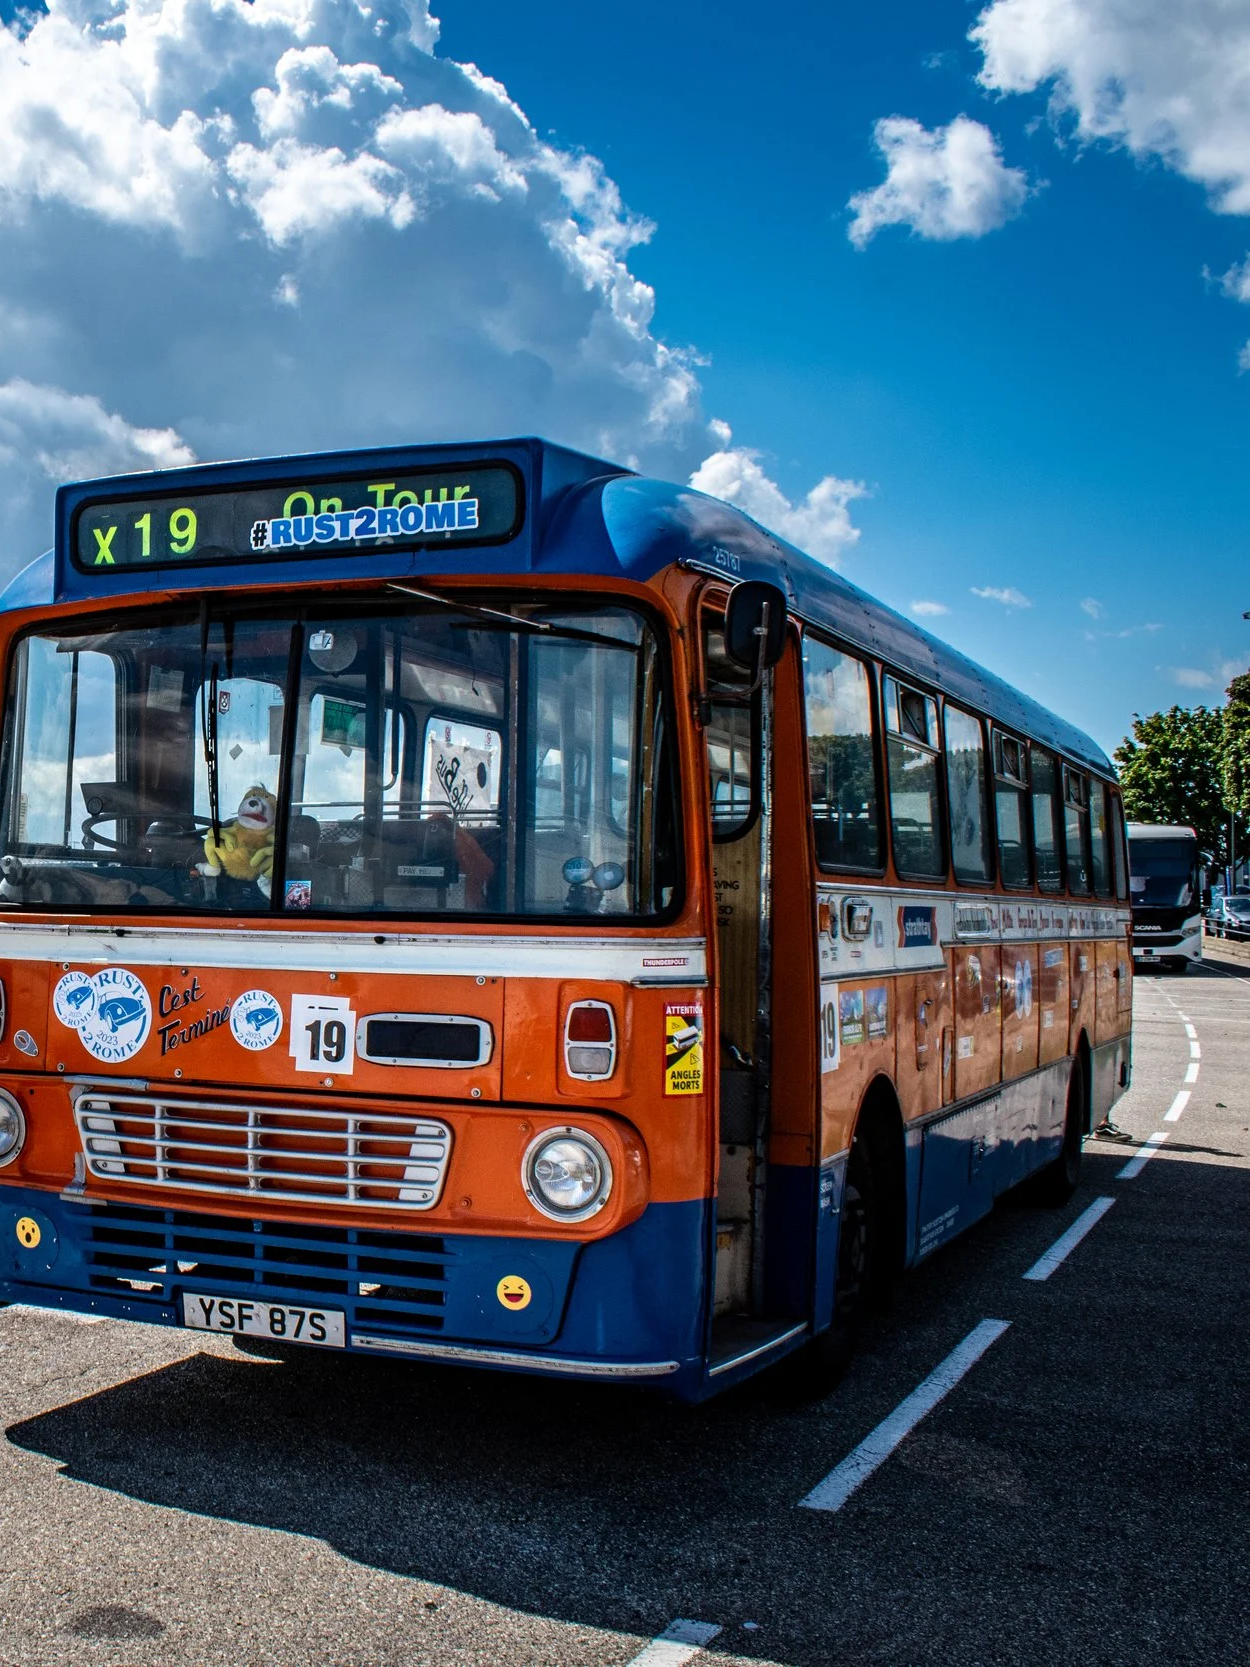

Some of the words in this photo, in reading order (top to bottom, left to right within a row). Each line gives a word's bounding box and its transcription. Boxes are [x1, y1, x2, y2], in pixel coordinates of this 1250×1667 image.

[252, 500, 478, 549] #RUST2ROME
[643, 958, 684, 967] THUNDERPOLE
[62, 973, 89, 986] RUST
[98, 970, 144, 998] RUST
[243, 991, 275, 1007] RUST
[67, 1010, 93, 1026] ROME
[157, 997, 232, 1057] Terminé
[245, 1030, 262, 1040] 2023
[821, 1001, 836, 1059] 19
[96, 1029, 119, 1046] 2023
[244, 1034, 275, 1048] ROME
[305, 1019, 347, 1063] 19
[83, 1032, 94, 1044] 2
[93, 1040, 137, 1060] ROME
[670, 1070, 701, 1080] ANGLES
[672, 1080, 700, 1090] MORTS
[199, 1298, 255, 1331] YSF
[269, 1307, 327, 1342] 87S
